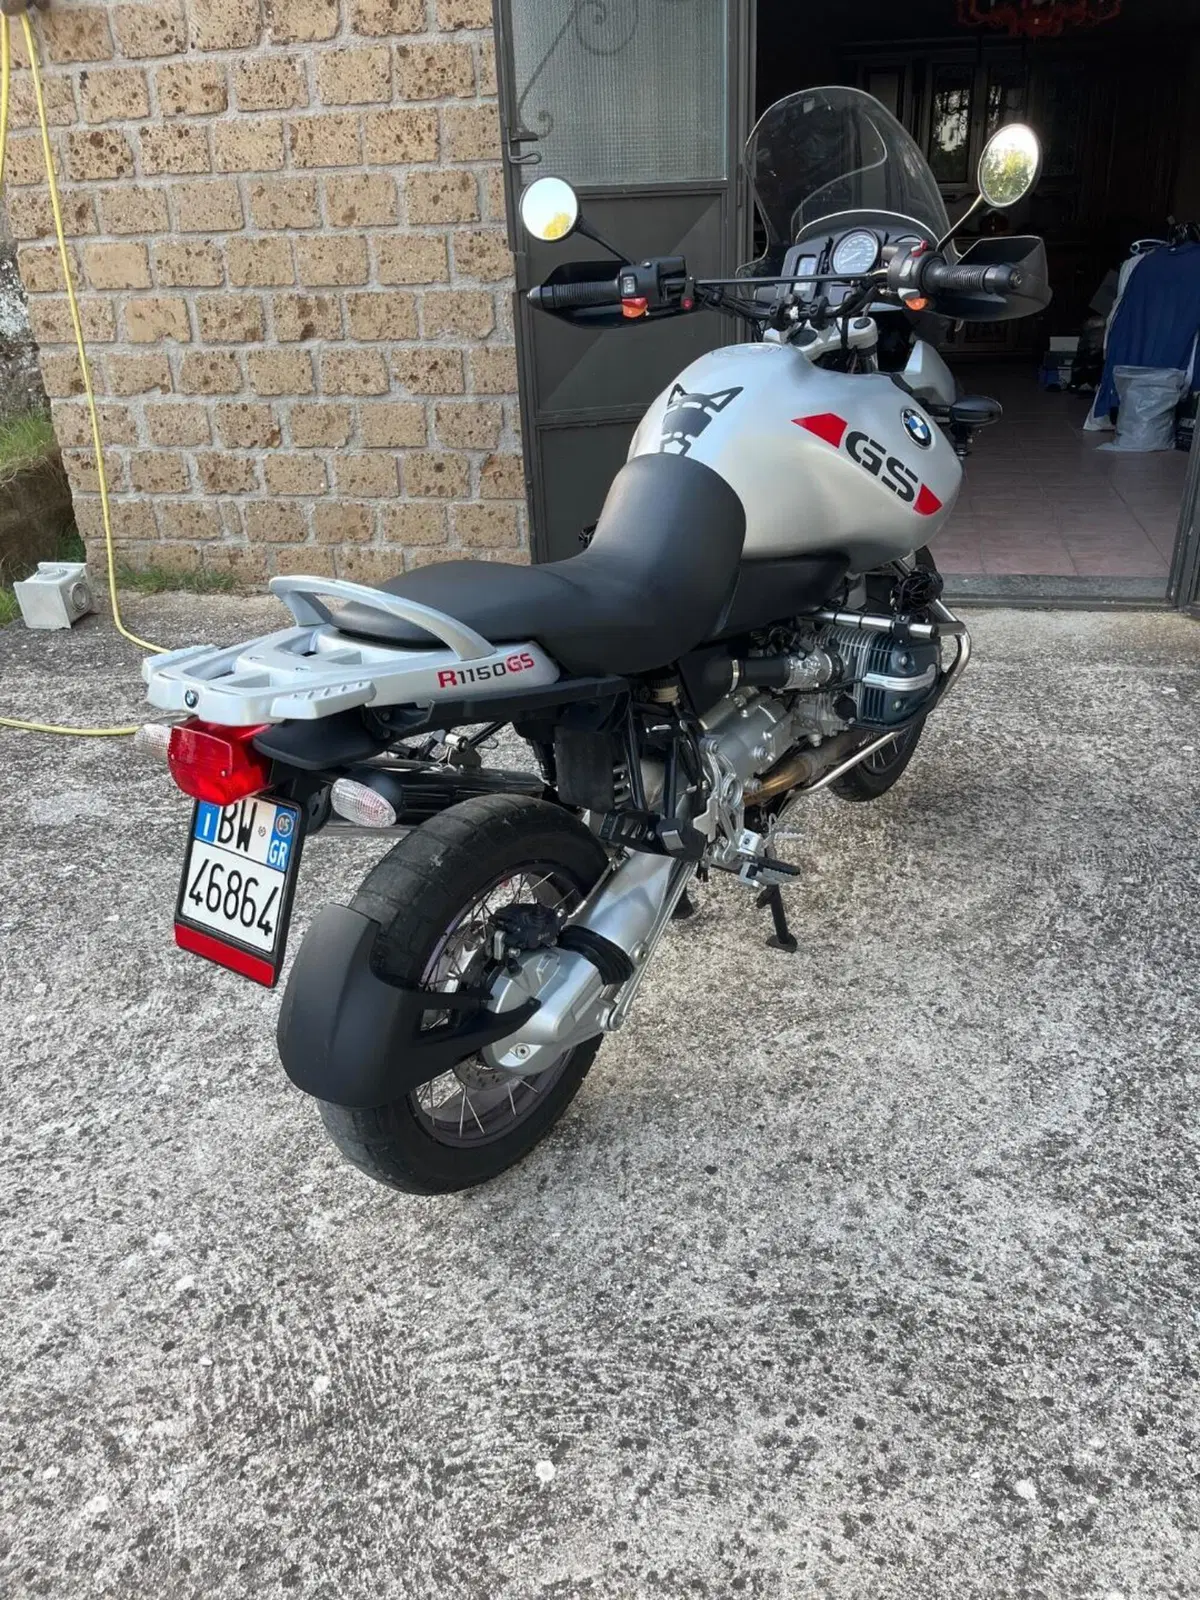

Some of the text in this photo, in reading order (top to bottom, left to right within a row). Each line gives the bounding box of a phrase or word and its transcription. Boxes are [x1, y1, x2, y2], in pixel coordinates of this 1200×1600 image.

[845, 431, 918, 502] GS
[437, 653, 535, 688] R1150GS
[218, 799, 258, 852] BW
[268, 840, 288, 867] GR
[189, 859, 279, 936] 46864
